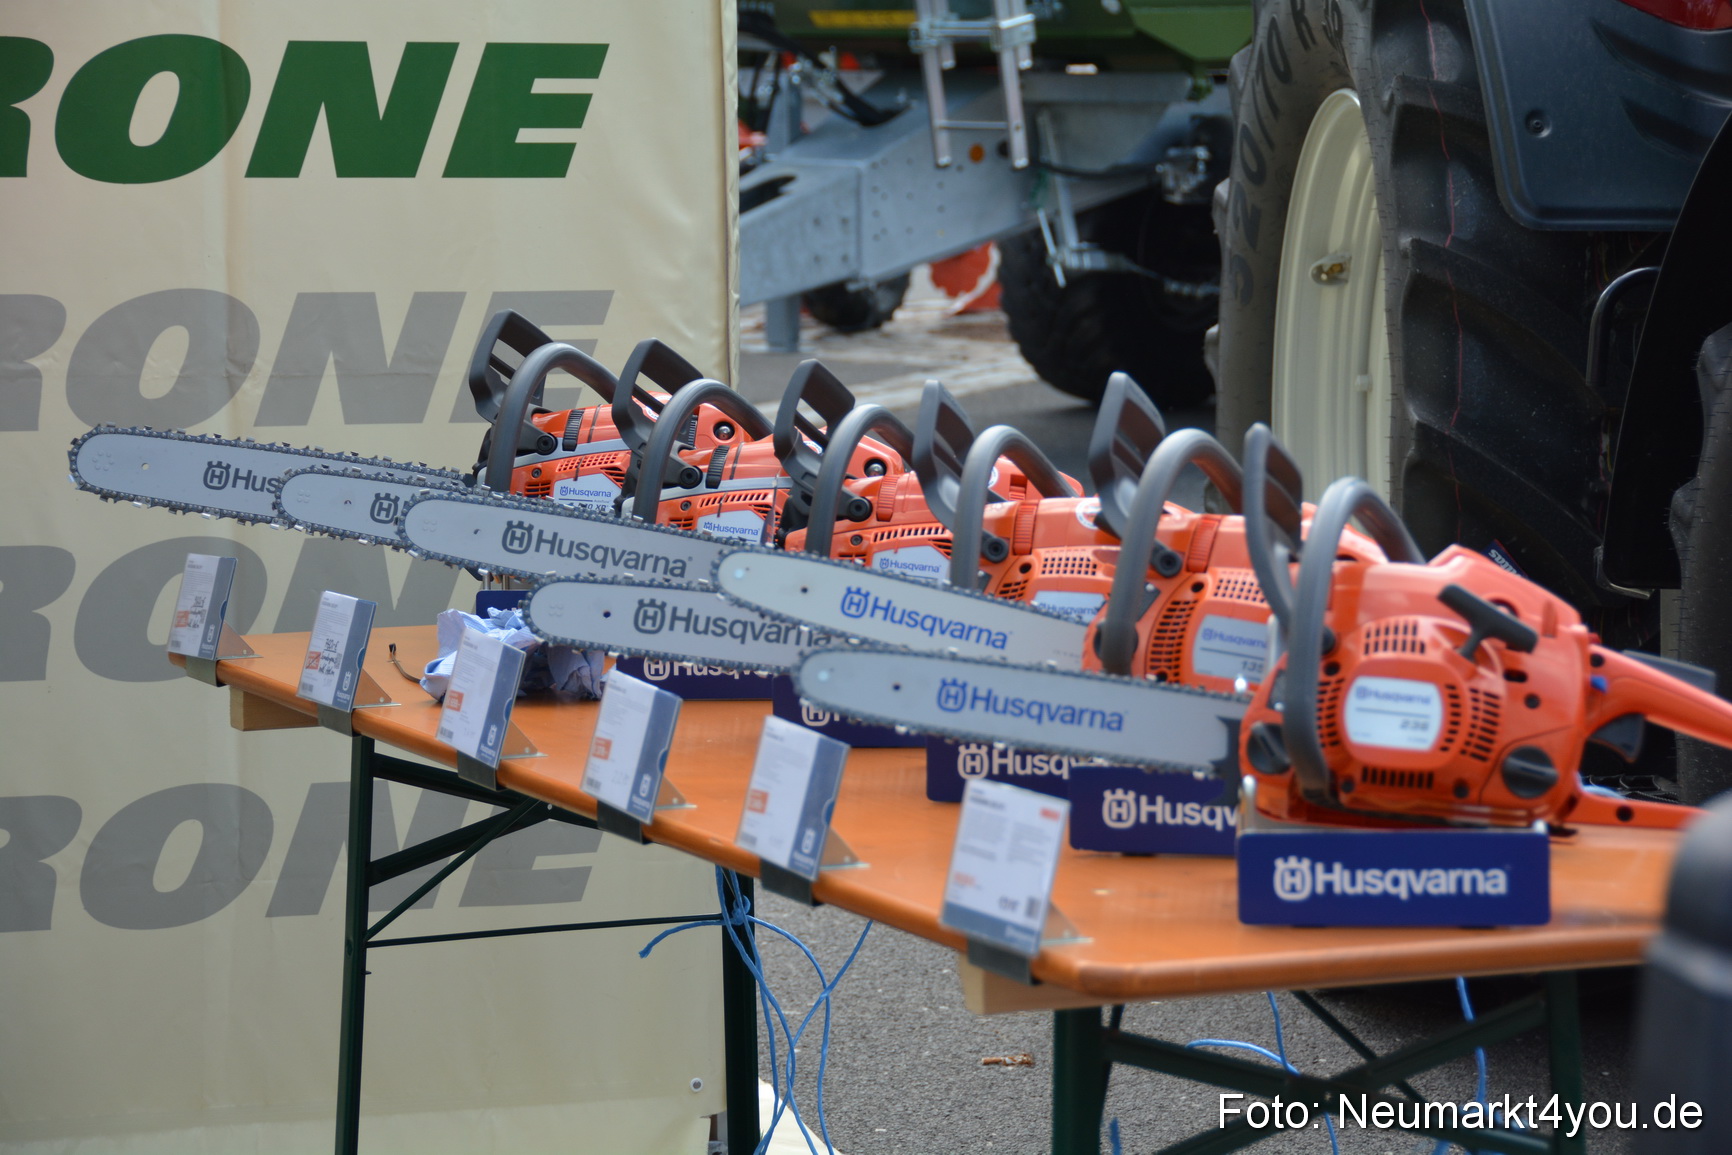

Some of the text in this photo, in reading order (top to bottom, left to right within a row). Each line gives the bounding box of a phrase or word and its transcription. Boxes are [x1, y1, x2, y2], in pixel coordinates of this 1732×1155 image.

[568, 487, 612, 498] Husqvarna
[713, 523, 759, 536] Husqvarna
[534, 529, 687, 578] Husqvarna
[889, 559, 940, 574] Husqvarna
[869, 597, 1008, 649] Husqvarna
[970, 686, 1124, 732] Husqvarna
[1314, 861, 1507, 900] Husqvarna
